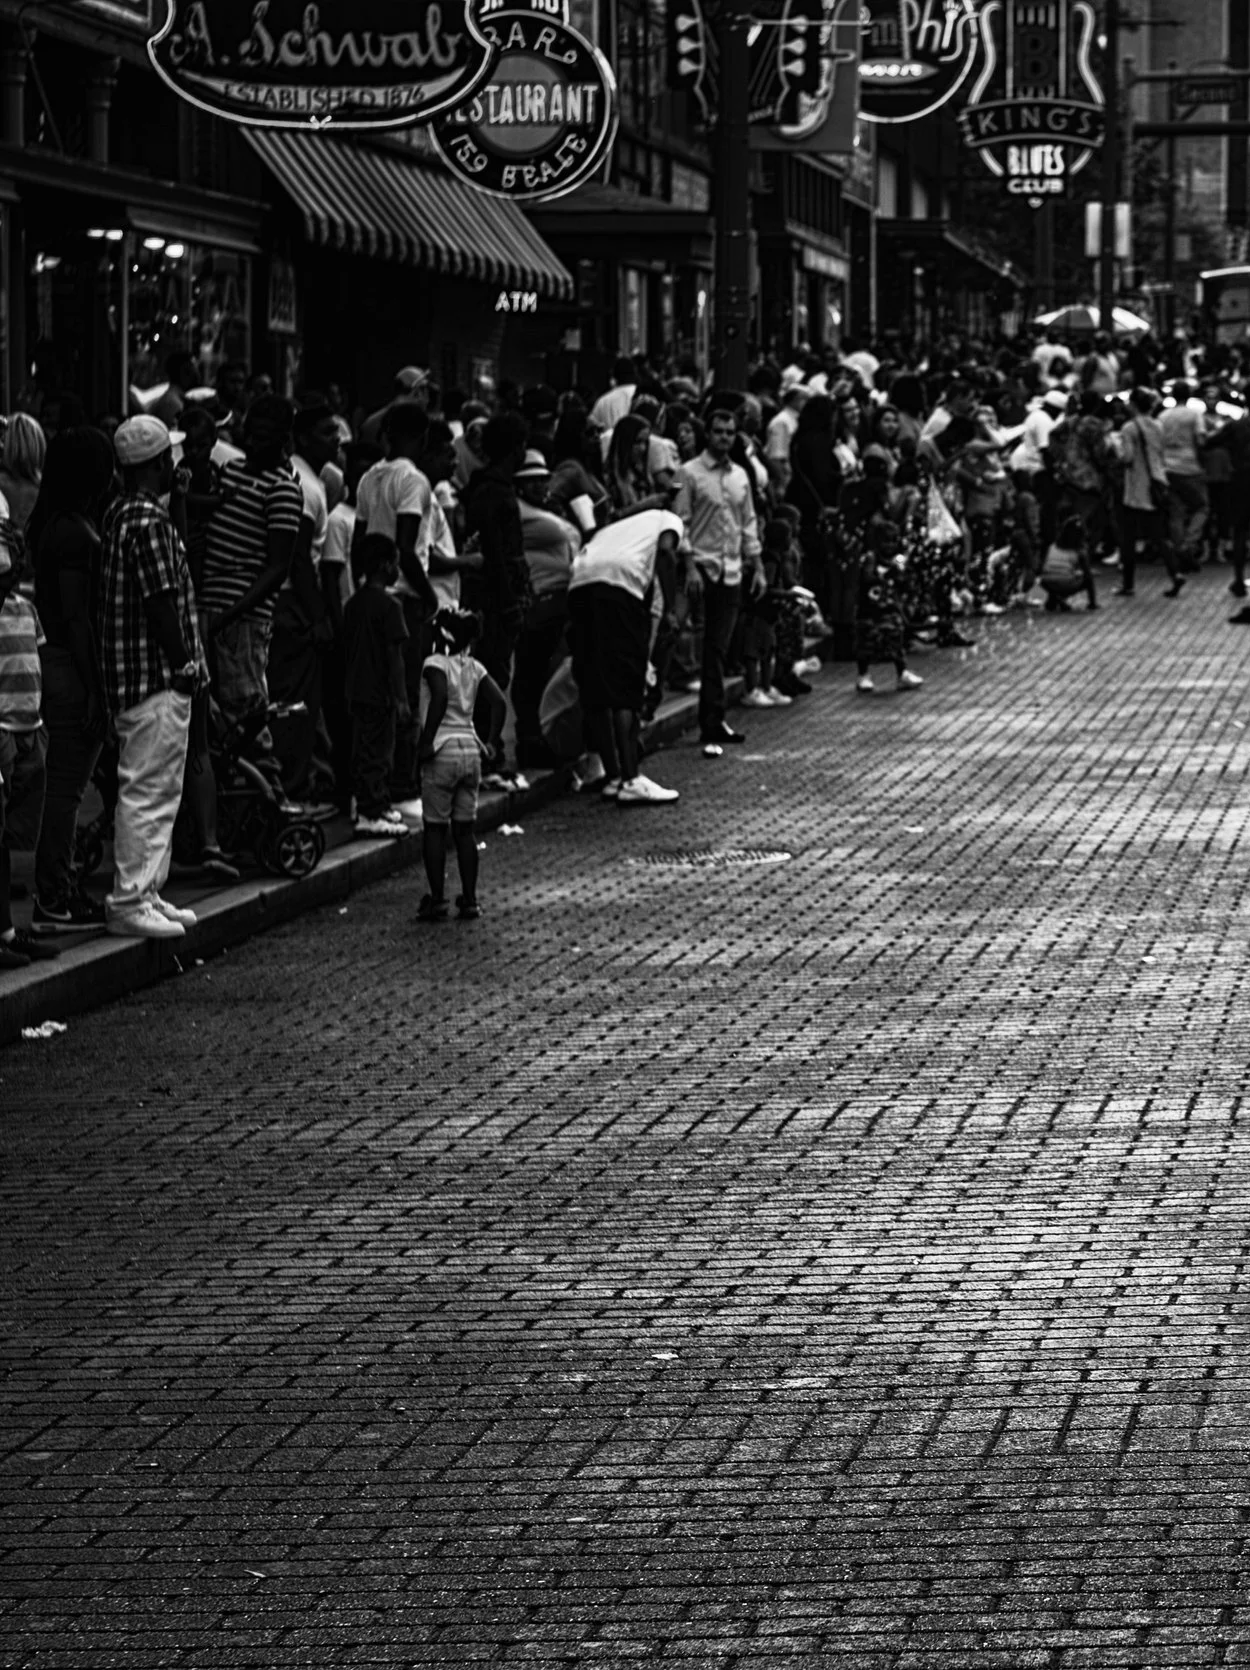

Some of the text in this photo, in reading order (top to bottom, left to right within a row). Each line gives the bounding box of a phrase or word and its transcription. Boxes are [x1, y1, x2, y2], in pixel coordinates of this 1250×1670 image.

[168, 0, 464, 68] A. Schwab
[223, 83, 425, 111] ESTABLISHED 1876
[445, 84, 599, 124] STAURANT
[976, 106, 1092, 135] KING'S
[449, 132, 588, 189] 159 BEALE
[1008, 145, 1065, 175] BLUES
[1008, 178, 1063, 194] CLUB
[494, 290, 538, 313] ATM
